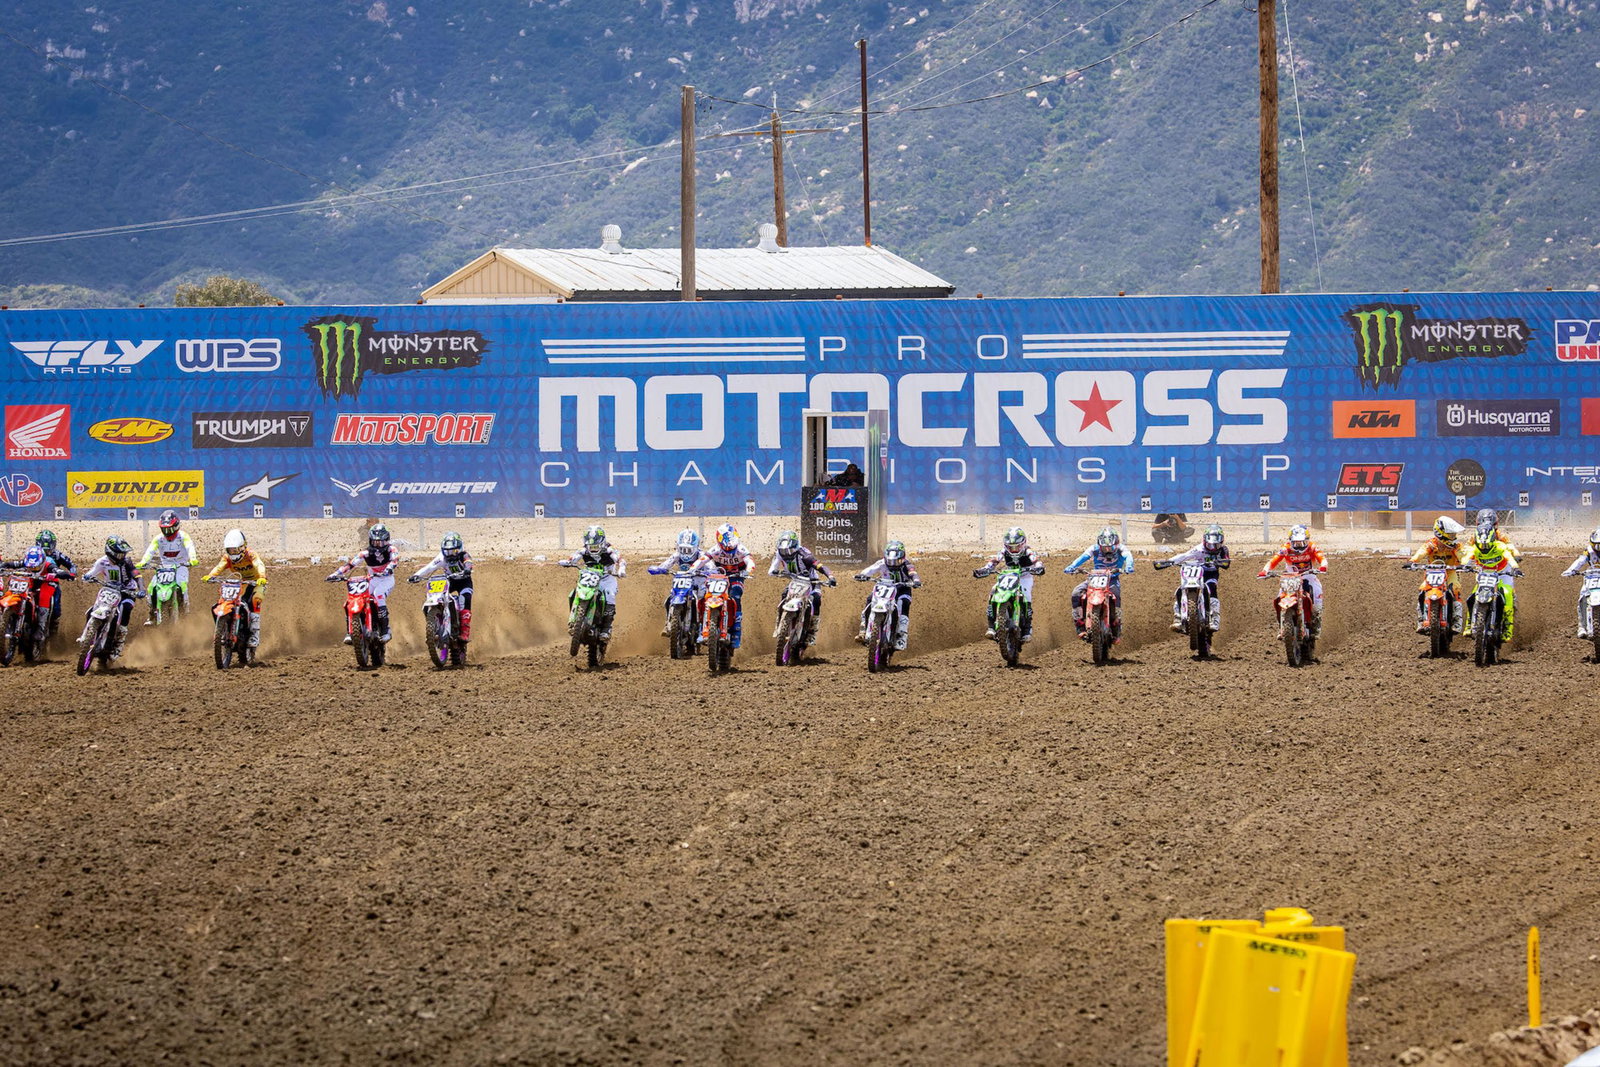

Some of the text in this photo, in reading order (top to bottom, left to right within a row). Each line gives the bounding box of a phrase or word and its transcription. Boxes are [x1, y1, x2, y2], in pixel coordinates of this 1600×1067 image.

[1411, 322, 1523, 342] MONSTER
[369, 334, 479, 354] MONSTER
[819, 334, 1008, 361] PRO
[176, 339, 281, 372] WPS
[1557, 345, 1600, 360] UN
[384, 357, 461, 365] ENERGY
[44, 366, 131, 374] RACING
[538, 368, 1288, 452] MOTOCROSS
[1348, 411, 1401, 428] KTM
[1467, 409, 1551, 425] Husqvarna
[91, 420, 173, 438] FMF
[195, 418, 286, 440] TRIUMPH
[9, 448, 67, 457] HONDA
[1341, 466, 1401, 485] ETS
[0, 474, 30, 506] VP
[92, 481, 199, 494] DUNLOP
[377, 482, 498, 494] LANDMASTER
[811, 489, 856, 502] AMA
[809, 503, 858, 511] 100 YEARS
[816, 517, 853, 528] Rights.
[816, 532, 853, 544] Riding.
[815, 546, 854, 557] Racing.
[348, 581, 370, 594] 30
[428, 580, 447, 593] 38
[707, 581, 727, 592] 16
[875, 586, 894, 598] 31
